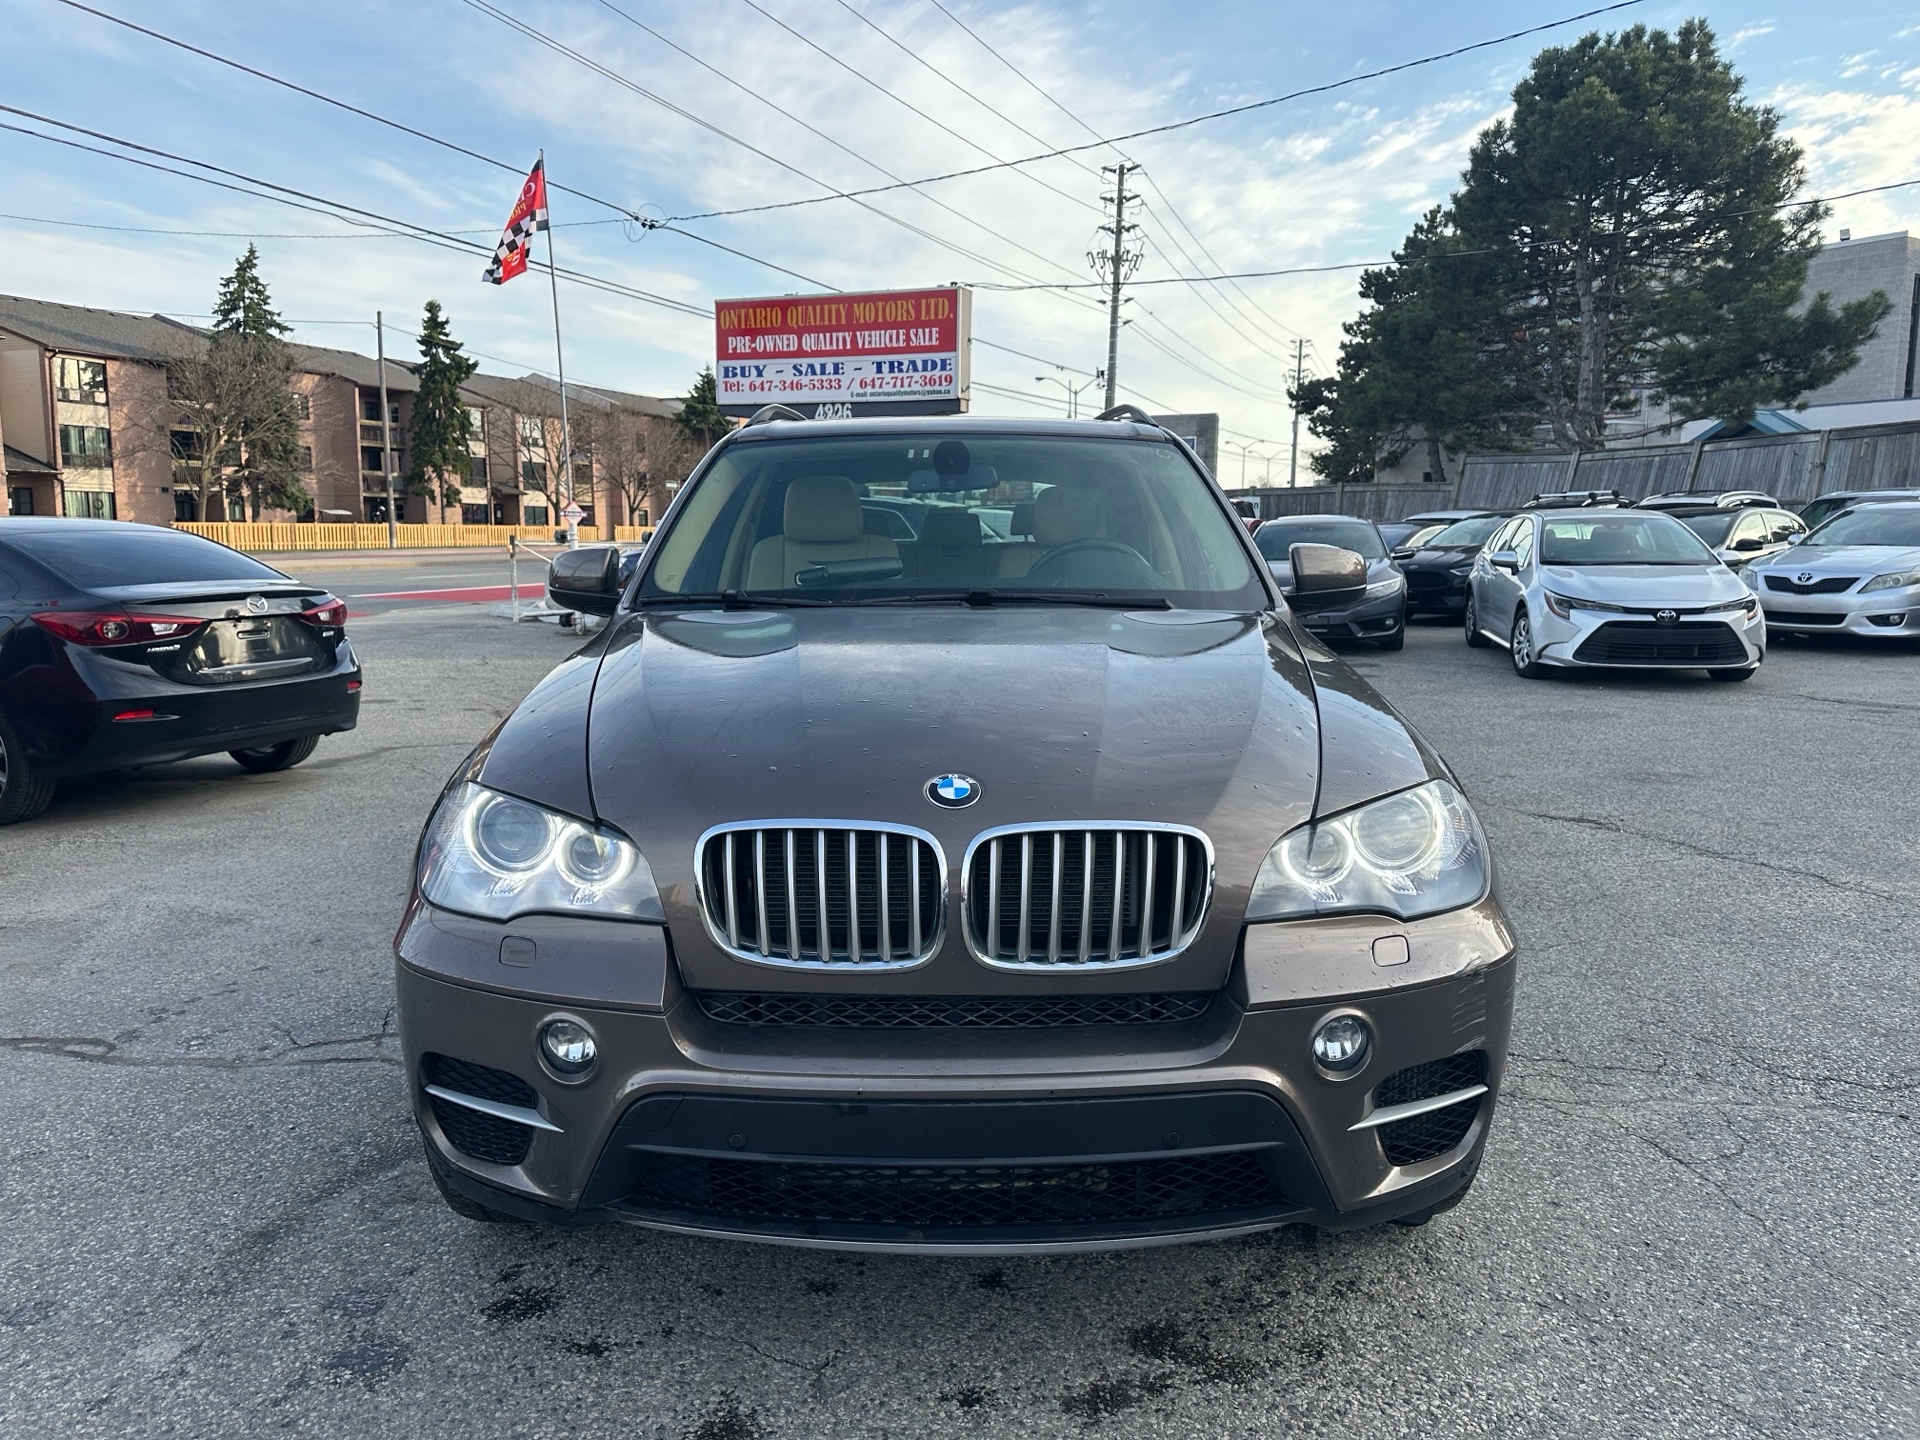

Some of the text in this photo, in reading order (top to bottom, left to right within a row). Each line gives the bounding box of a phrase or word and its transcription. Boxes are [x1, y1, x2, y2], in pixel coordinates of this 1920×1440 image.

[720, 297, 954, 330] ONTARIO QUALITY MOTORS LTD.
[727, 327, 940, 353] PRE-OWNED QUALITY VEHICLE SALE
[722, 365, 767, 379] BUY
[792, 362, 845, 377] SALE
[872, 357, 953, 374] TRADE
[722, 380, 745, 392] Tel:
[748, 377, 842, 392] 647-346-5333
[859, 373, 954, 389] 647-717-3619
[850, 390, 868, 398] E-mail:
[814, 402, 853, 419] 4926
[931, 774, 976, 784] BMW
